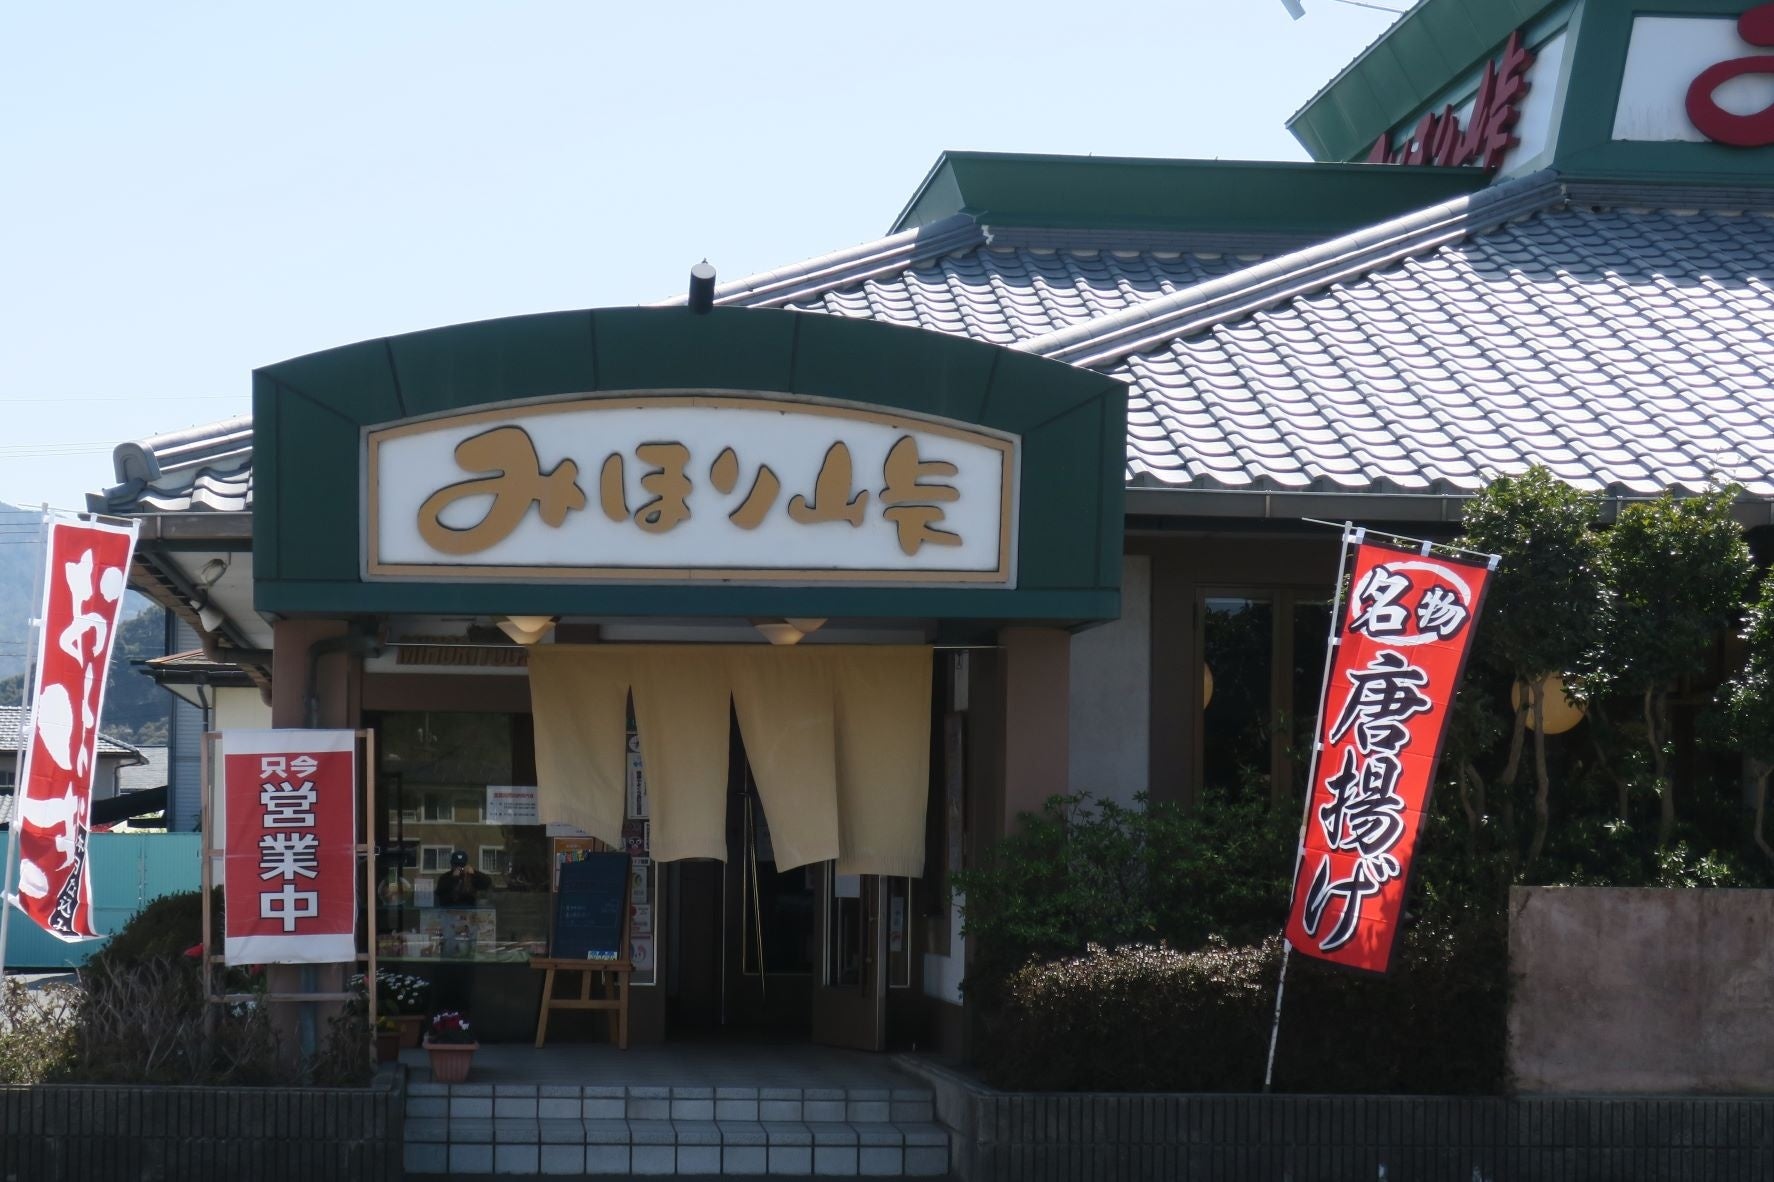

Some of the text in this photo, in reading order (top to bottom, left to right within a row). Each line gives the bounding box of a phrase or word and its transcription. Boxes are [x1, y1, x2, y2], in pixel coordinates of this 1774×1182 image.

[1348, 564, 1471, 640] 名物
[259, 755, 319, 779] 只今
[1302, 650, 1431, 951] 唐揚げ
[258, 780, 319, 933] 営業中
